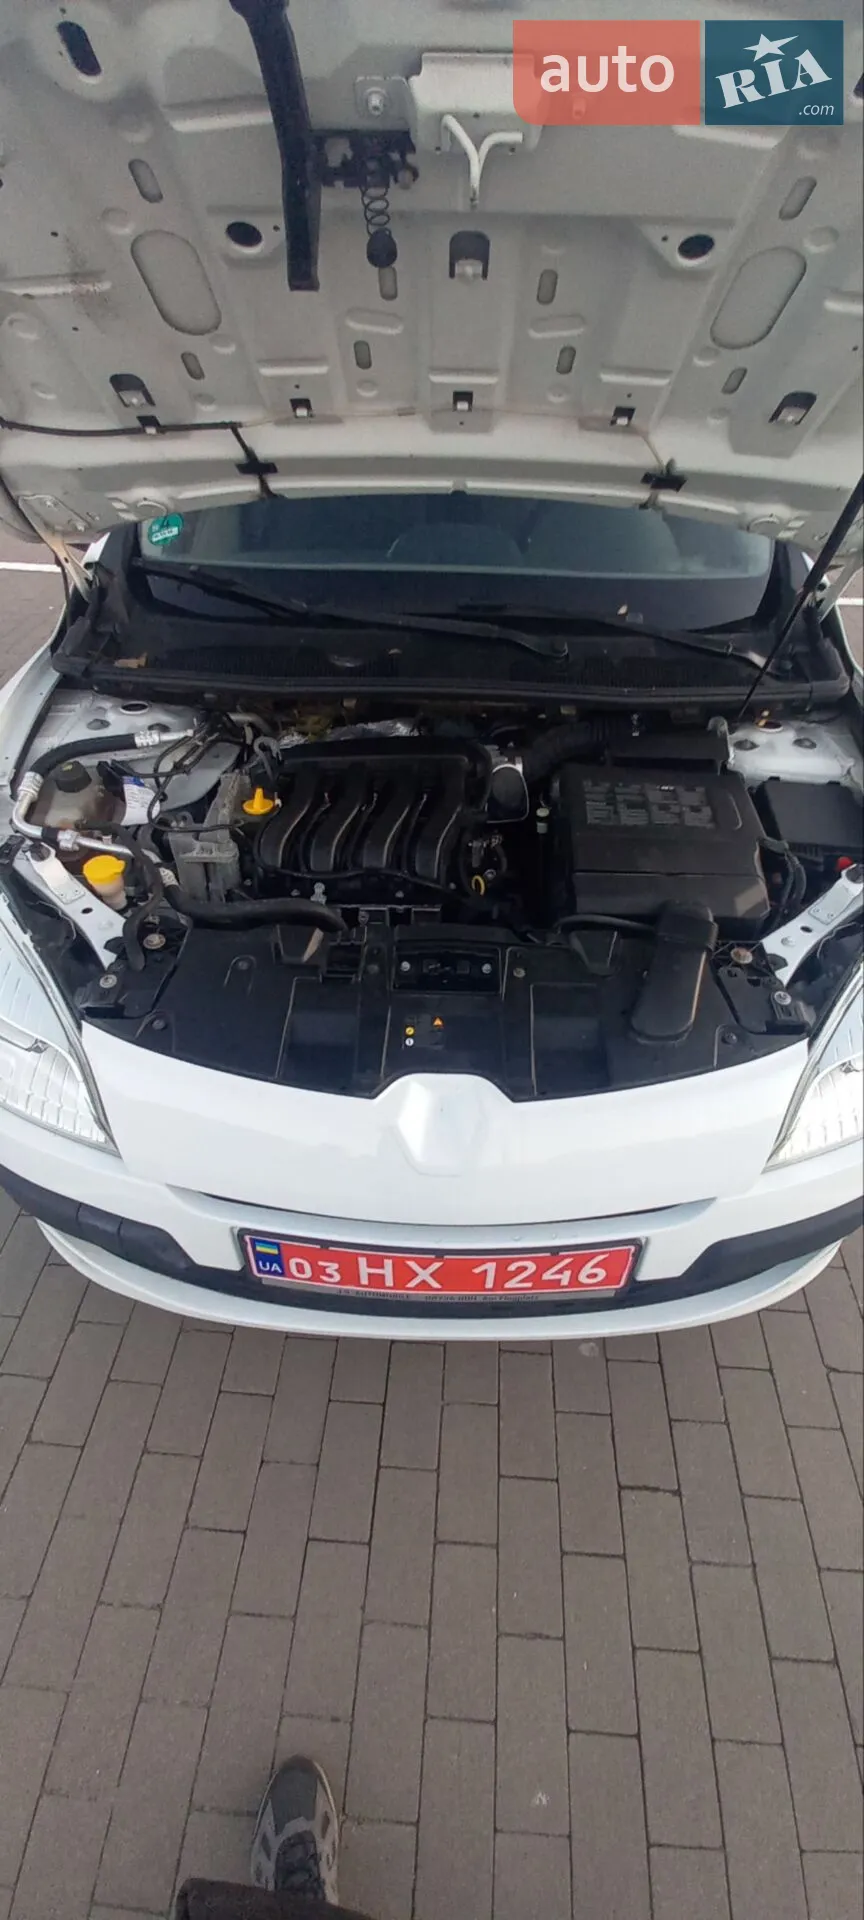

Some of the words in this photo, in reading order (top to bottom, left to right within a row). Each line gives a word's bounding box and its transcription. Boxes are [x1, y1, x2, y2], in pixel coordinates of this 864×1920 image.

[259, 1260, 282, 1273] UA
[289, 1257, 341, 1283] 03
[358, 1256, 444, 1289] HX
[472, 1254, 609, 1289] 1246
